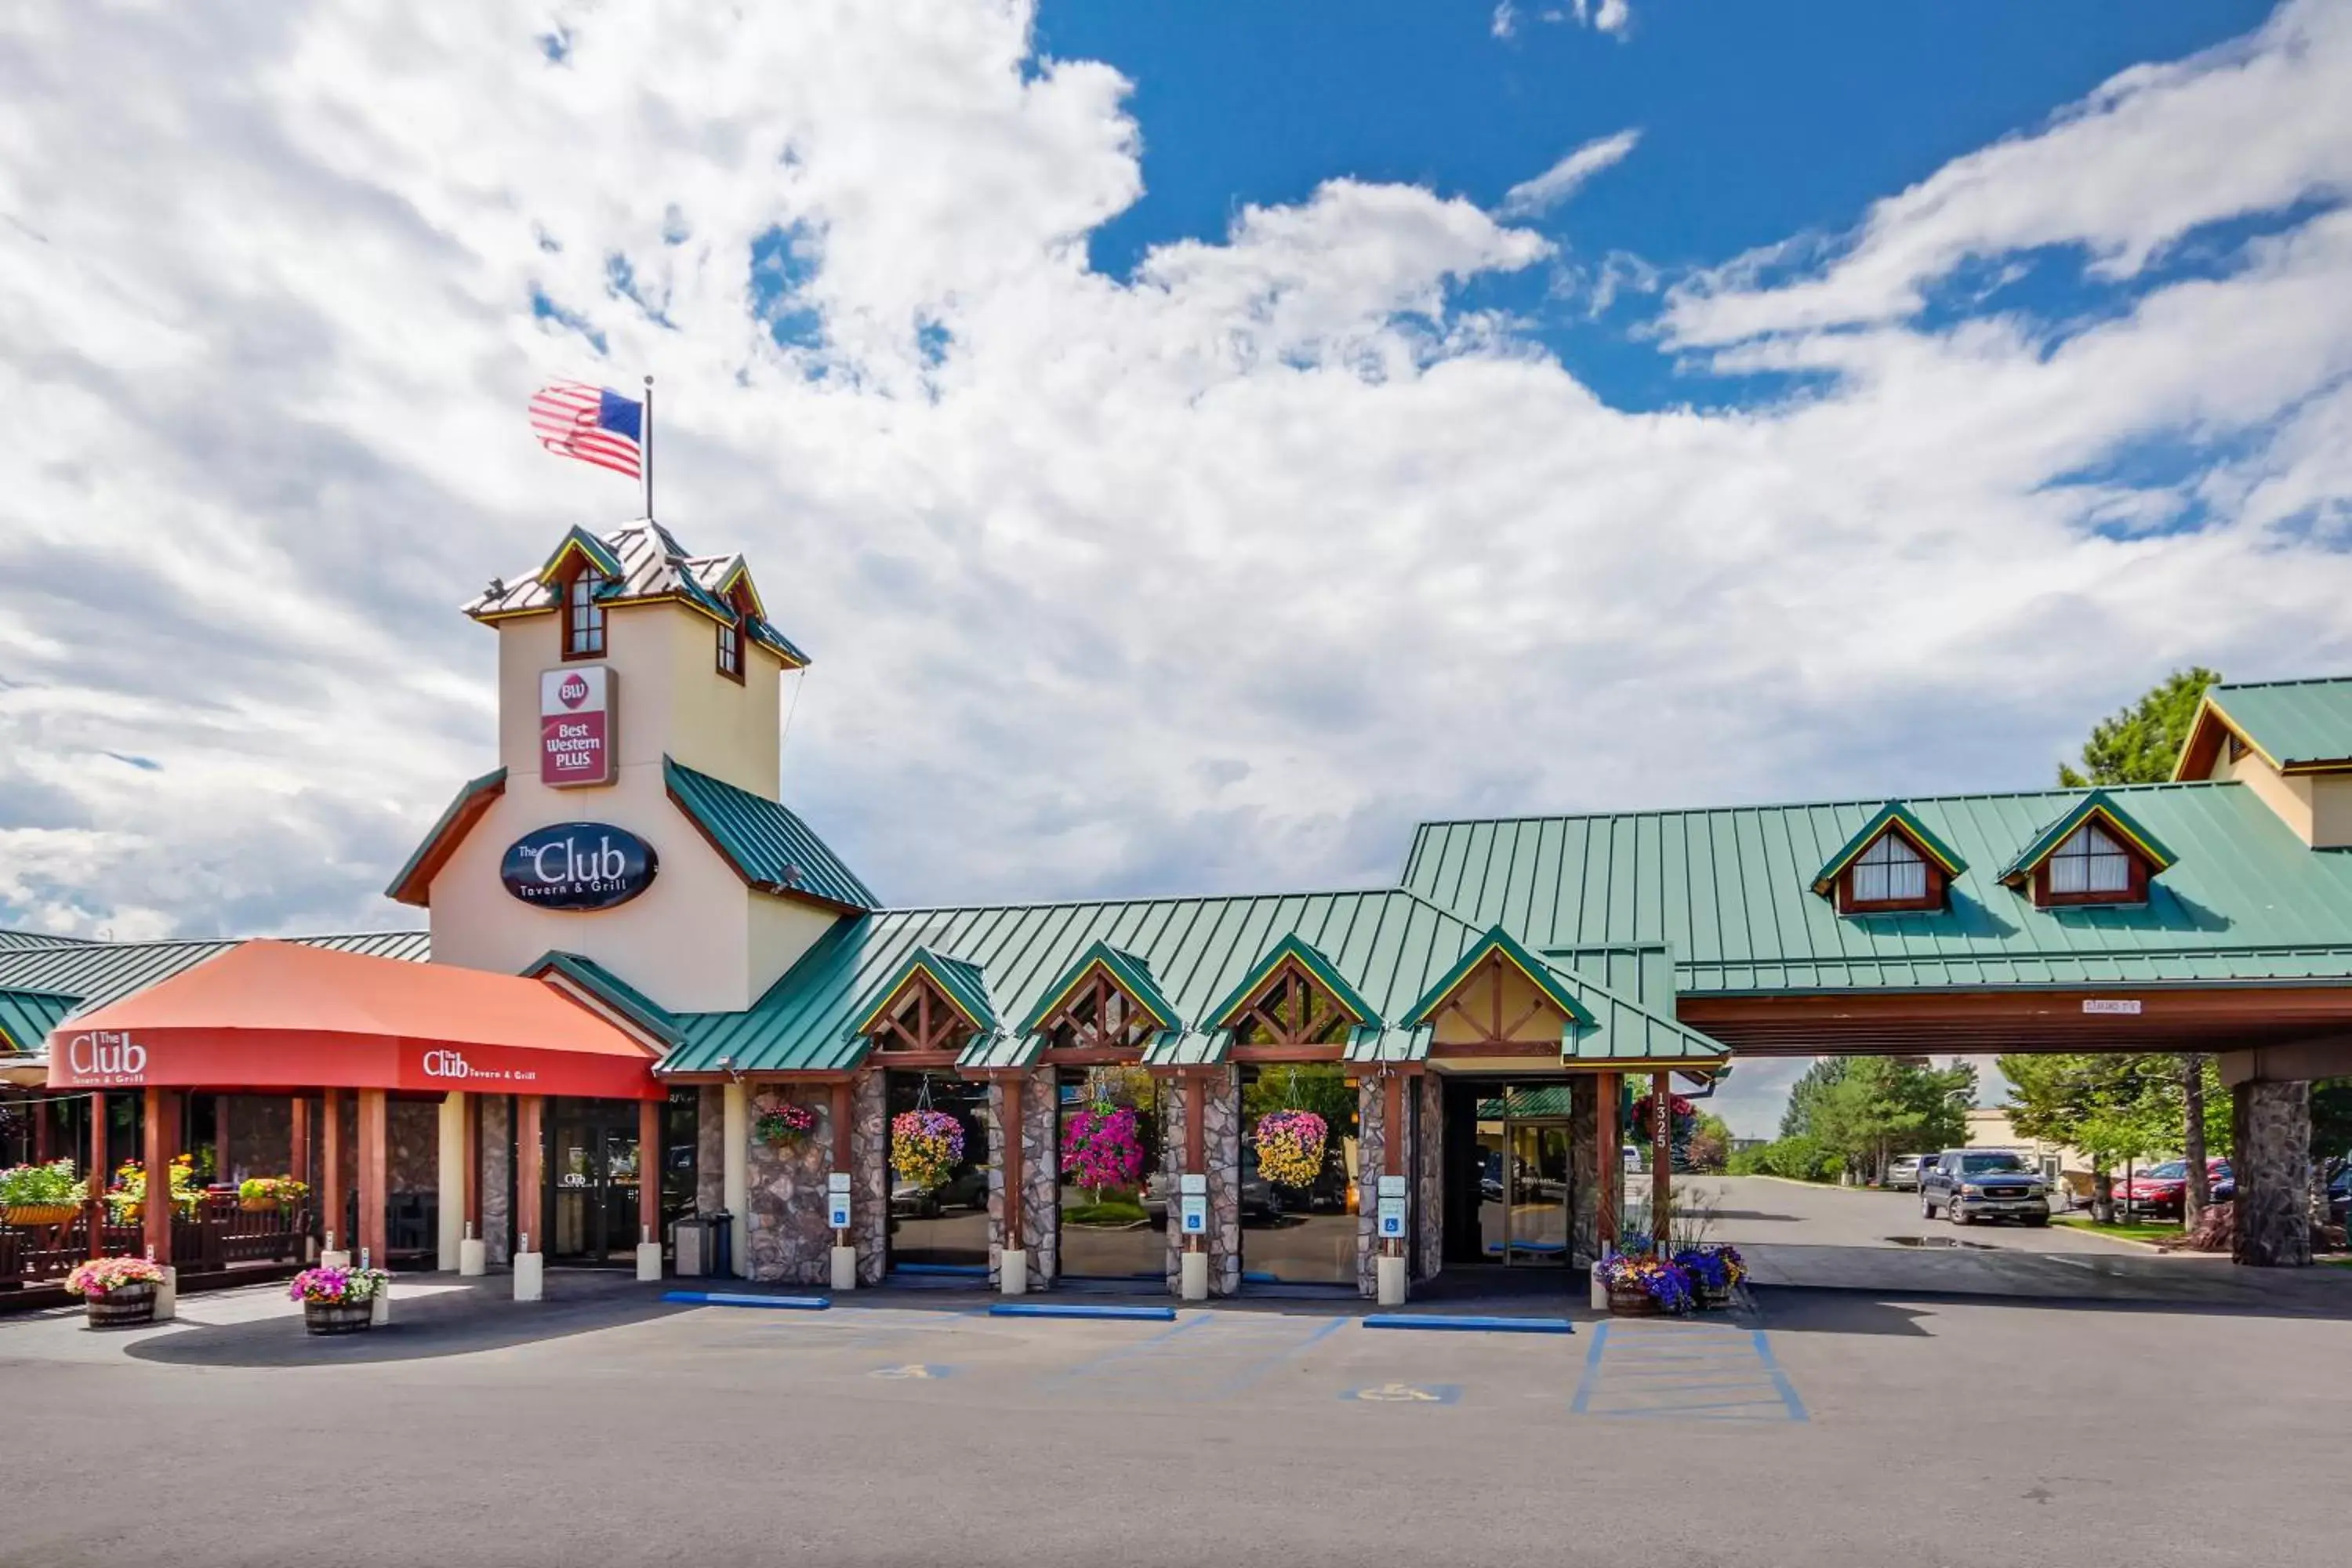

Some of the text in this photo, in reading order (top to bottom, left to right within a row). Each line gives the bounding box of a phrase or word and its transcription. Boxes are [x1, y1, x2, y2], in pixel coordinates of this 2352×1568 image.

[562, 683, 584, 699] BW
[559, 723, 588, 738] Best
[546, 738, 600, 752] Western
[556, 752, 590, 767] PLUS
[519, 836, 626, 884] The Club
[521, 879, 626, 897] Tavern & Grill
[70, 1031, 147, 1074] The Club
[423, 1050, 468, 1078] Club
[115, 1073, 143, 1083] Grill
[470, 1069, 501, 1079] Tavern
[1657, 1092, 1666, 1149] 1325
